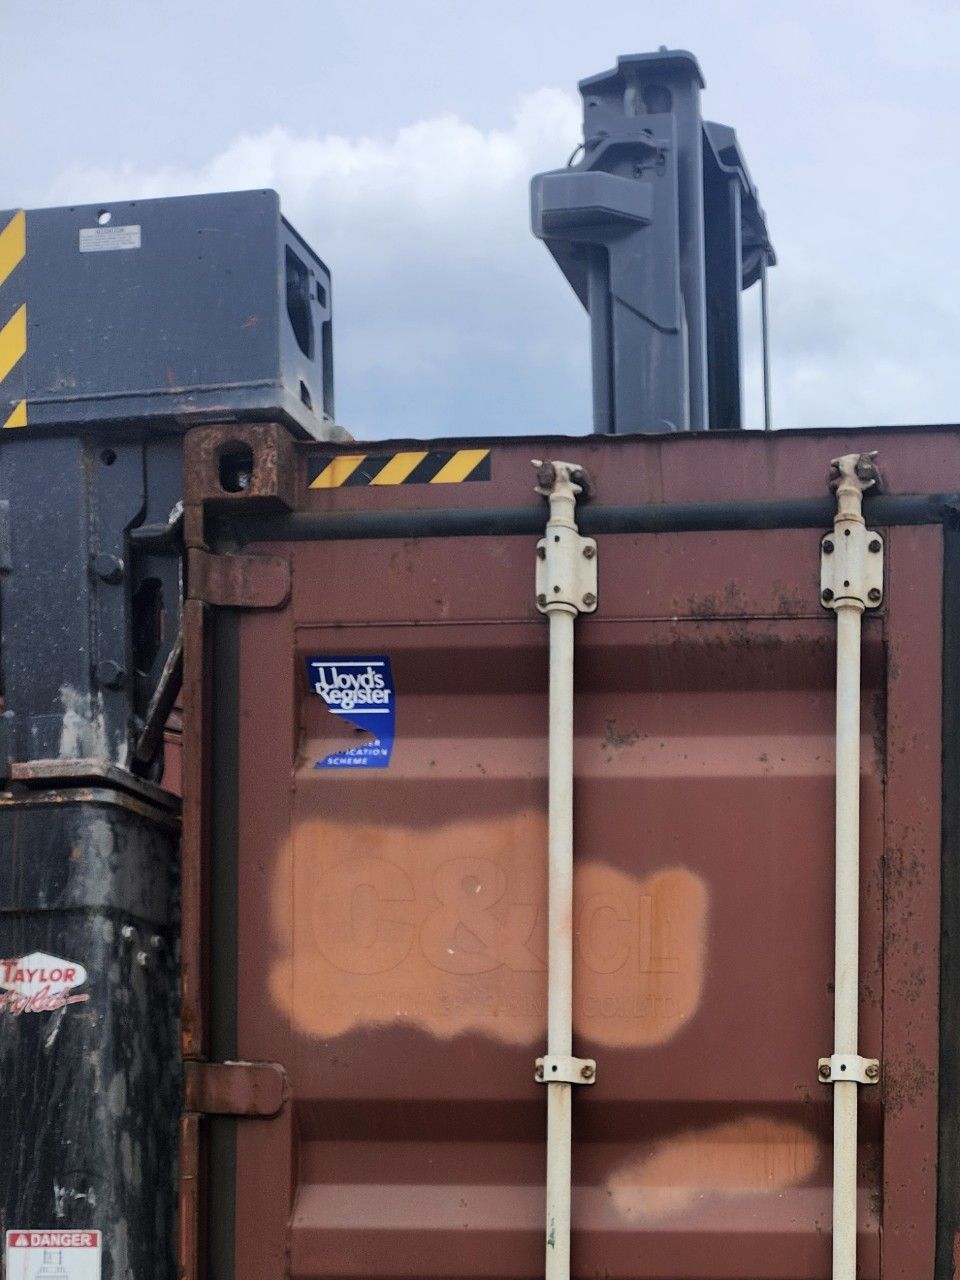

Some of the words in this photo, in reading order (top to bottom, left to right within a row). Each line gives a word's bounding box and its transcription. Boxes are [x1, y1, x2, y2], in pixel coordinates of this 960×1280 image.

[315, 682, 391, 710] Register
[1, 960, 76, 983] TAYLOR
[30, 1234, 92, 1247] DANGER
